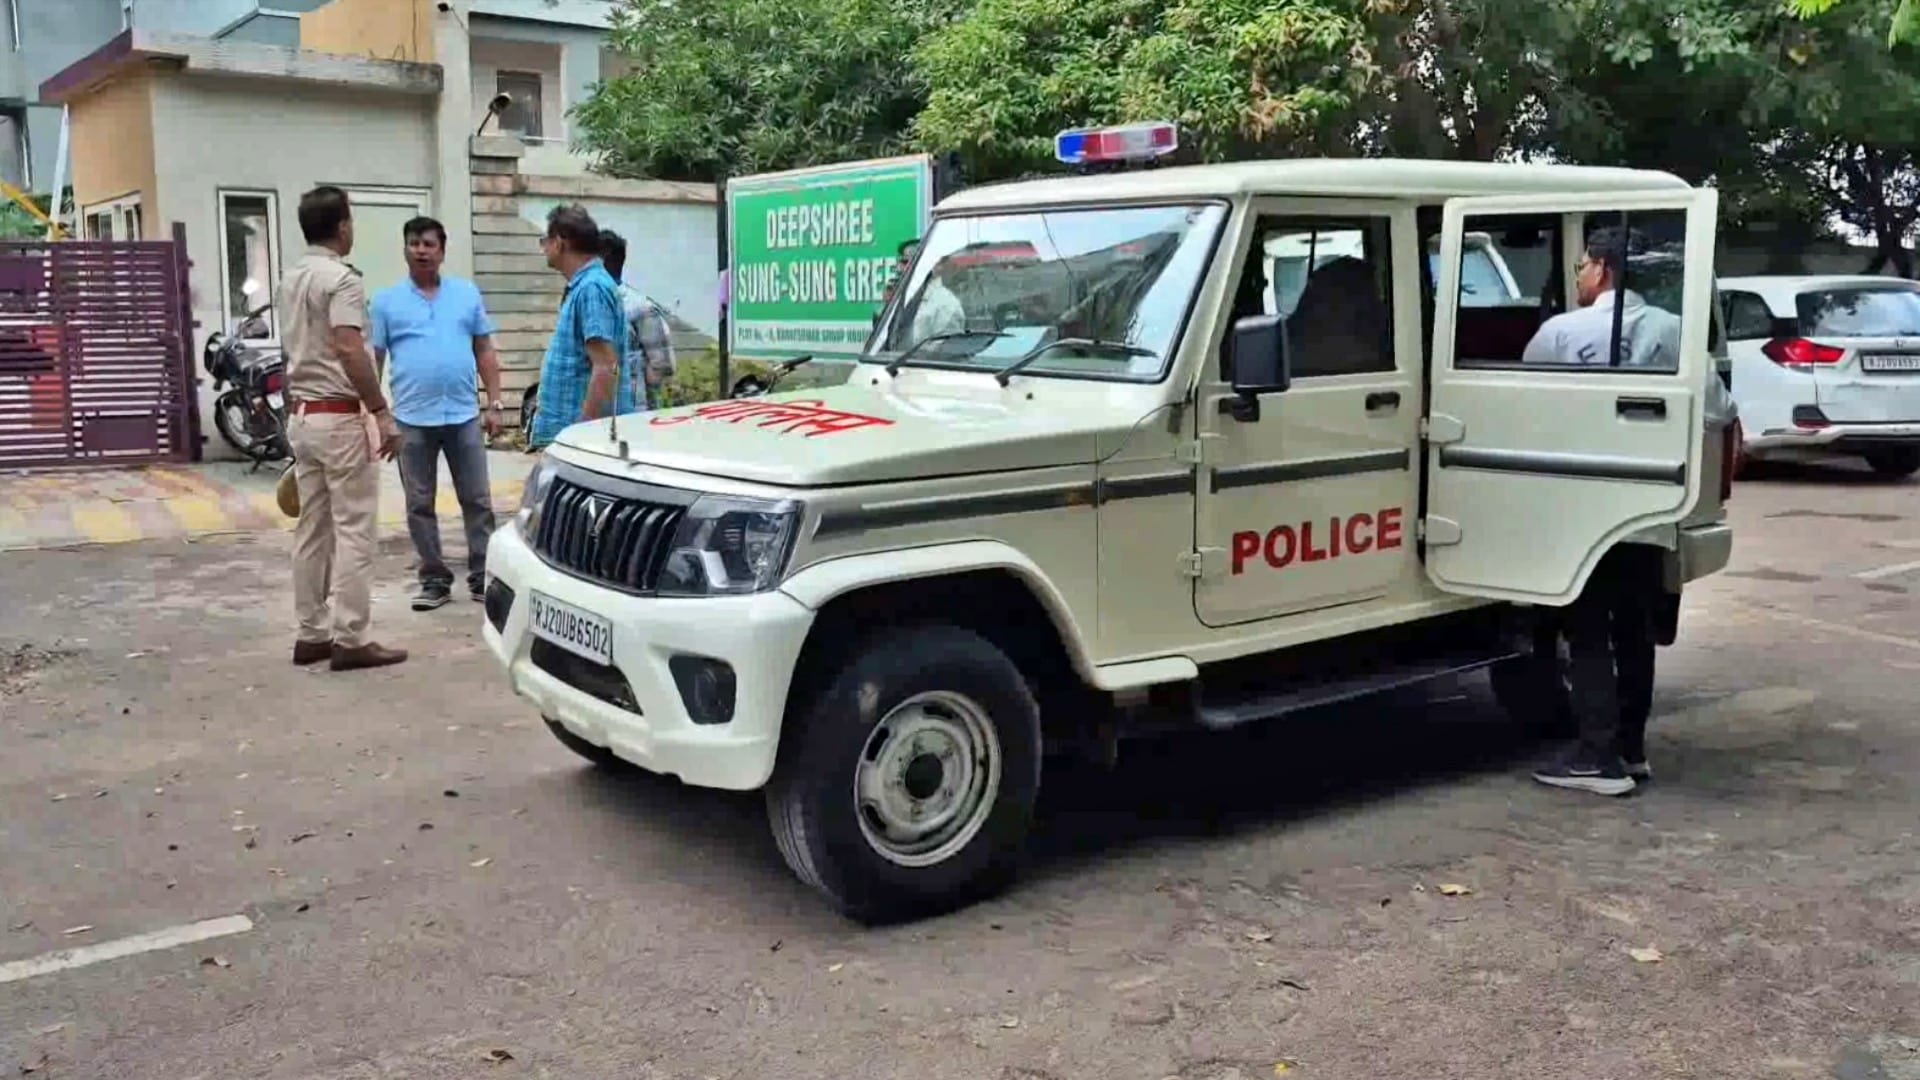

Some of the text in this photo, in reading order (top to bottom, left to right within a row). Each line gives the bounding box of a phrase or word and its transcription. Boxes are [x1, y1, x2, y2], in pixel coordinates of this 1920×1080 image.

[766, 198, 874, 249] DEEPSHREE
[738, 256, 898, 304] SUNG-SUNG GREE
[1232, 507, 1403, 576] POLICE
[535, 600, 608, 655] RJ20UB6502
